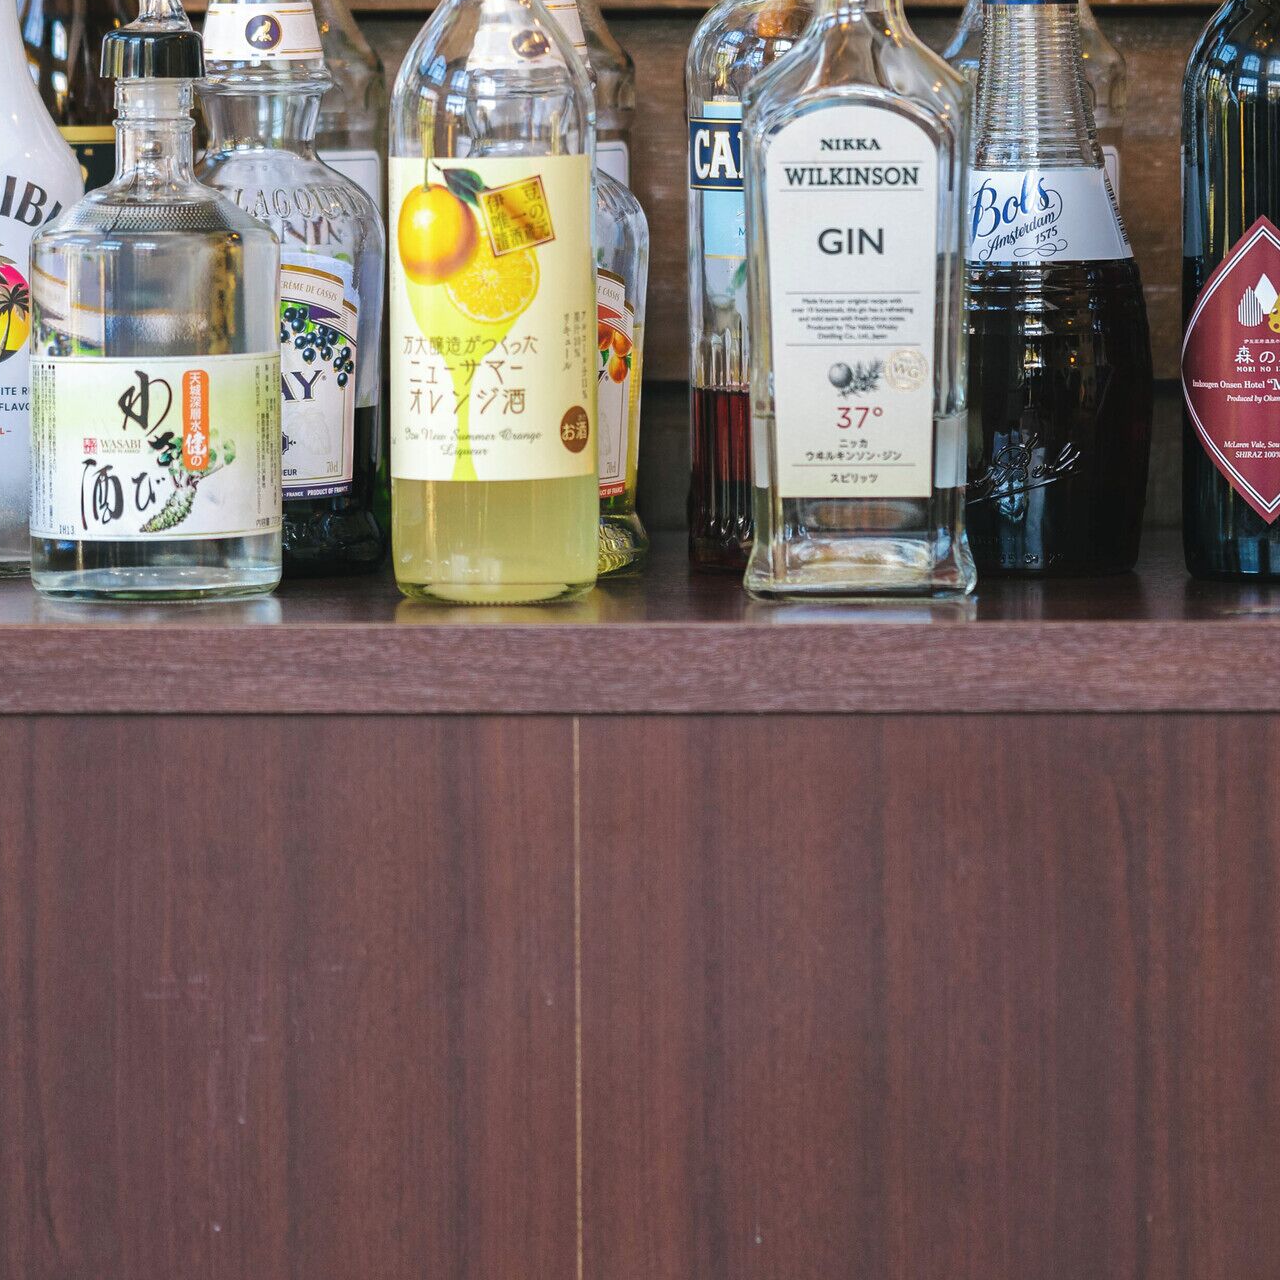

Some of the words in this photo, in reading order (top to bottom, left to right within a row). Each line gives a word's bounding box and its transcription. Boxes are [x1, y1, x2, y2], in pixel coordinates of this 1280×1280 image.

[820, 138, 881, 151] NIKKA
[784, 167, 919, 186] WILKINSON
[970, 173, 1062, 245] Bols
[818, 228, 884, 255] GIN
[978, 212, 1056, 261] Amsterdam
[1034, 225, 1058, 245] 1575
[410, 359, 523, 386] ニューサマー
[1220, 380, 1243, 389] Onsen
[1244, 380, 1265, 389] Hotel
[410, 388, 526, 415] オレンジ酒
[1226, 394, 1254, 402] Produced
[1254, 394, 1263, 404] by
[837, 406, 884, 429] 37°
[562, 421, 588, 442] お酒
[100, 439, 142, 449] WASABI
[839, 439, 869, 449] ニッカ
[1235, 451, 1263, 459] SHIRAZ
[307, 488, 328, 497] PRODUCT
